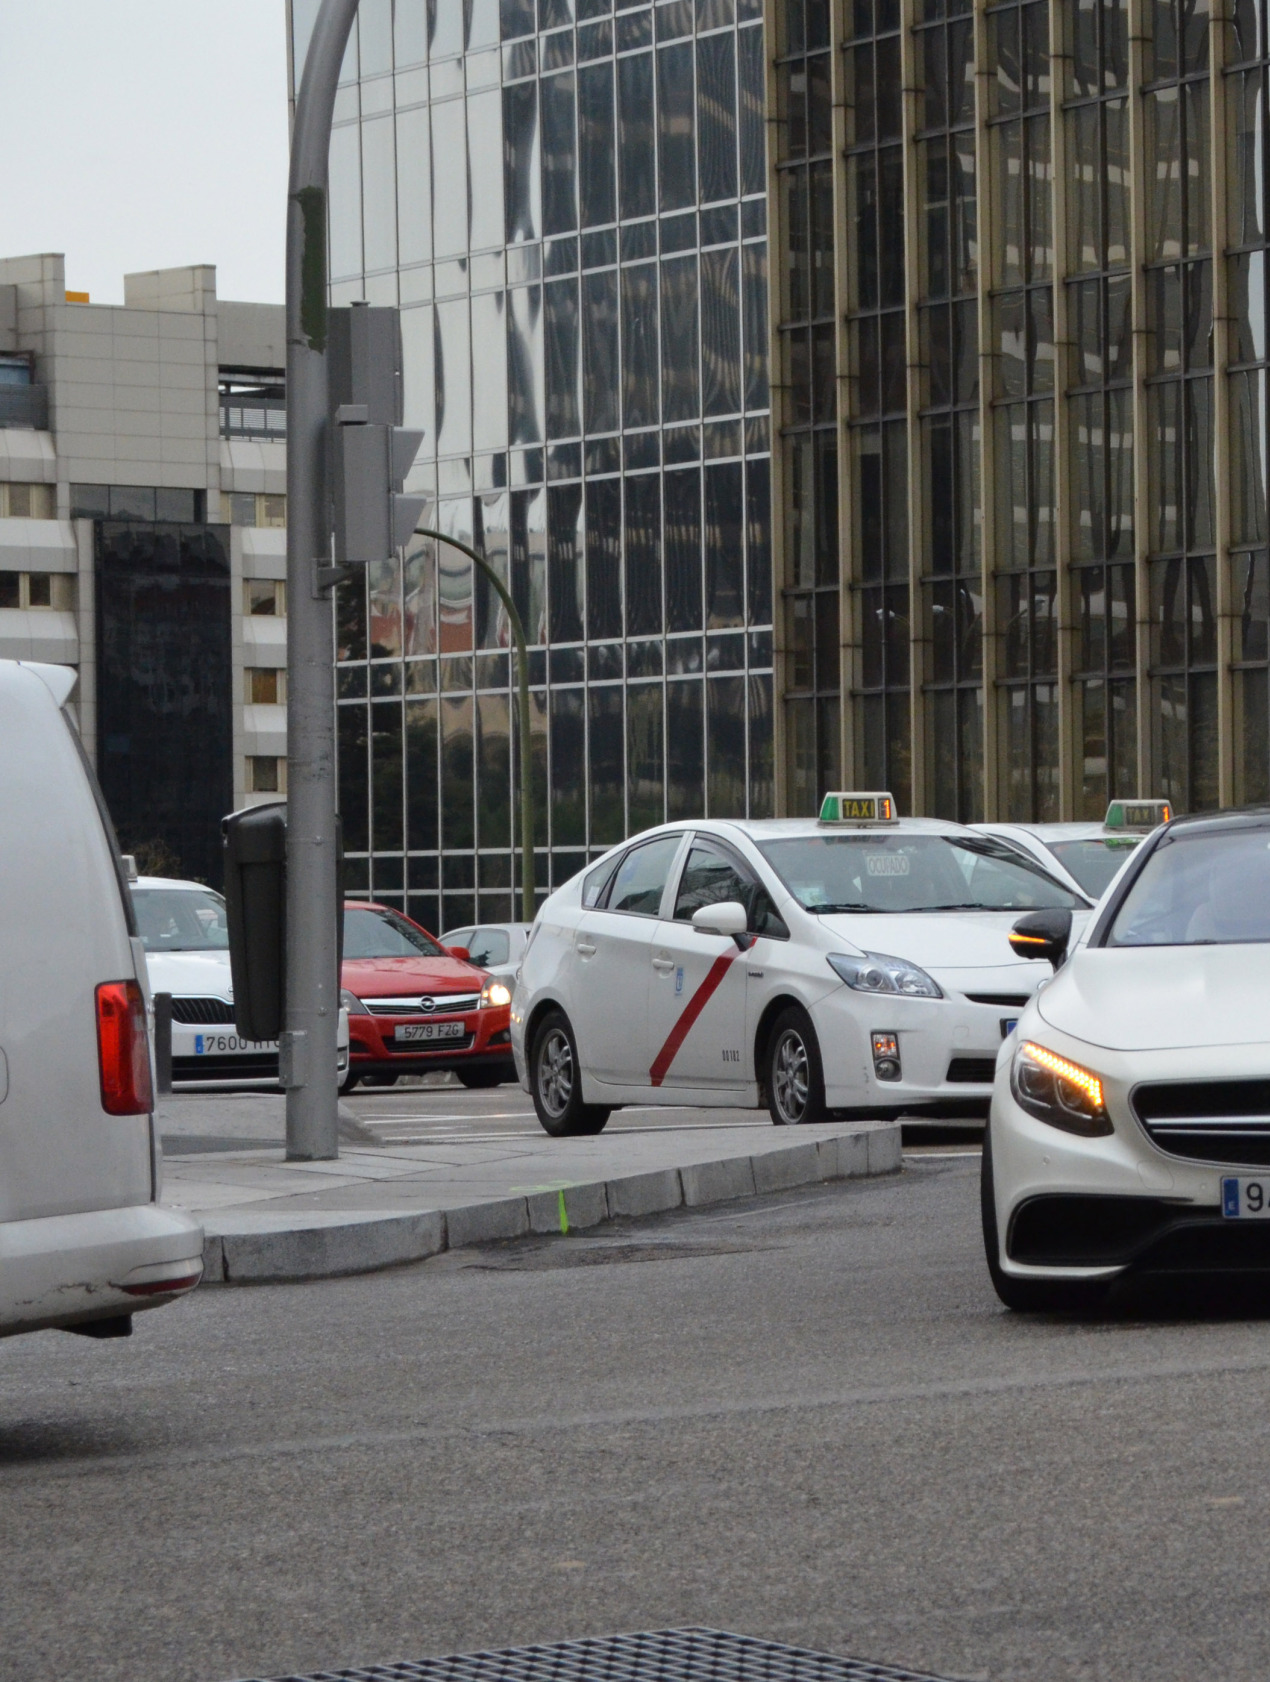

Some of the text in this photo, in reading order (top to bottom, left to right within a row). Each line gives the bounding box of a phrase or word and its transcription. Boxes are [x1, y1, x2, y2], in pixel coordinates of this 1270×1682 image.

[844, 799, 891, 819] TAXI 1
[1162, 806, 1169, 823] 1
[404, 1023, 459, 1039] 5779 FZG
[206, 1036, 248, 1051] 7600
